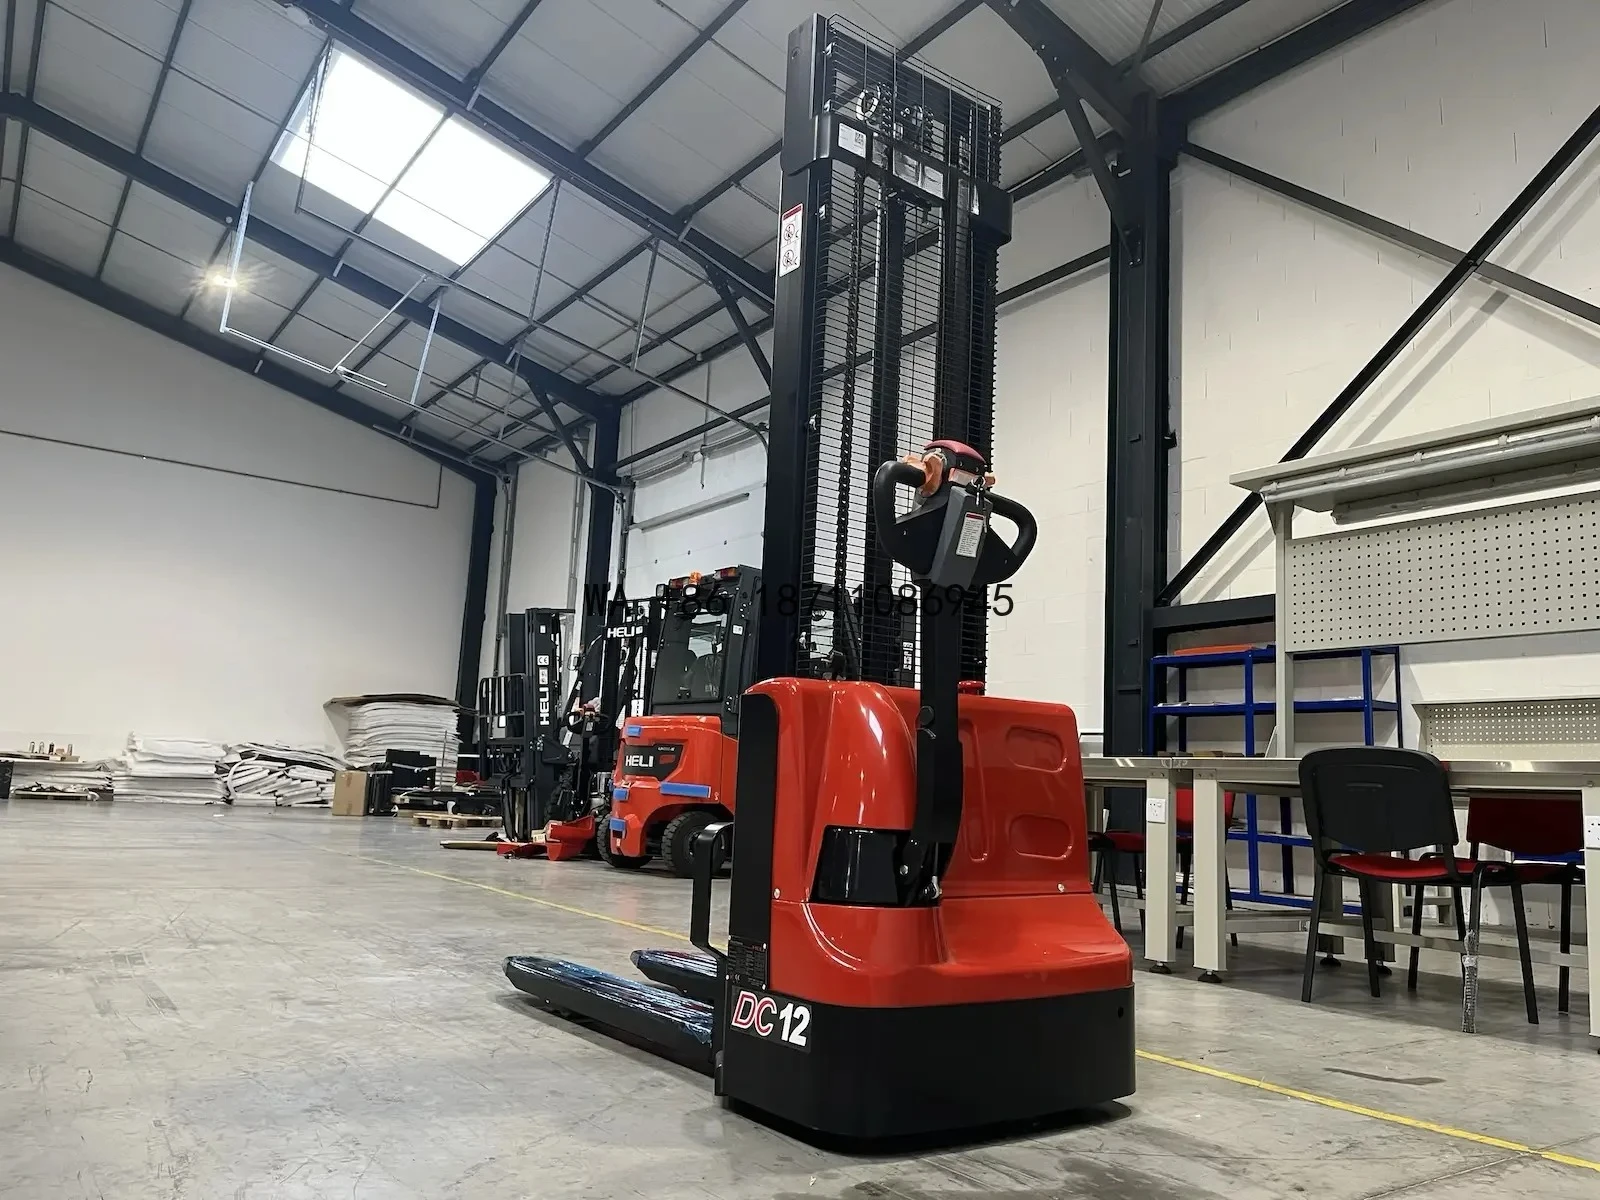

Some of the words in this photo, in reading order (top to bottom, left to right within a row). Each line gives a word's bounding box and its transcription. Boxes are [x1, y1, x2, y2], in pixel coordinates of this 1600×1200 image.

[607, 626, 635, 638] HELI
[539, 687, 550, 726] HELI
[625, 755, 654, 767] HELI
